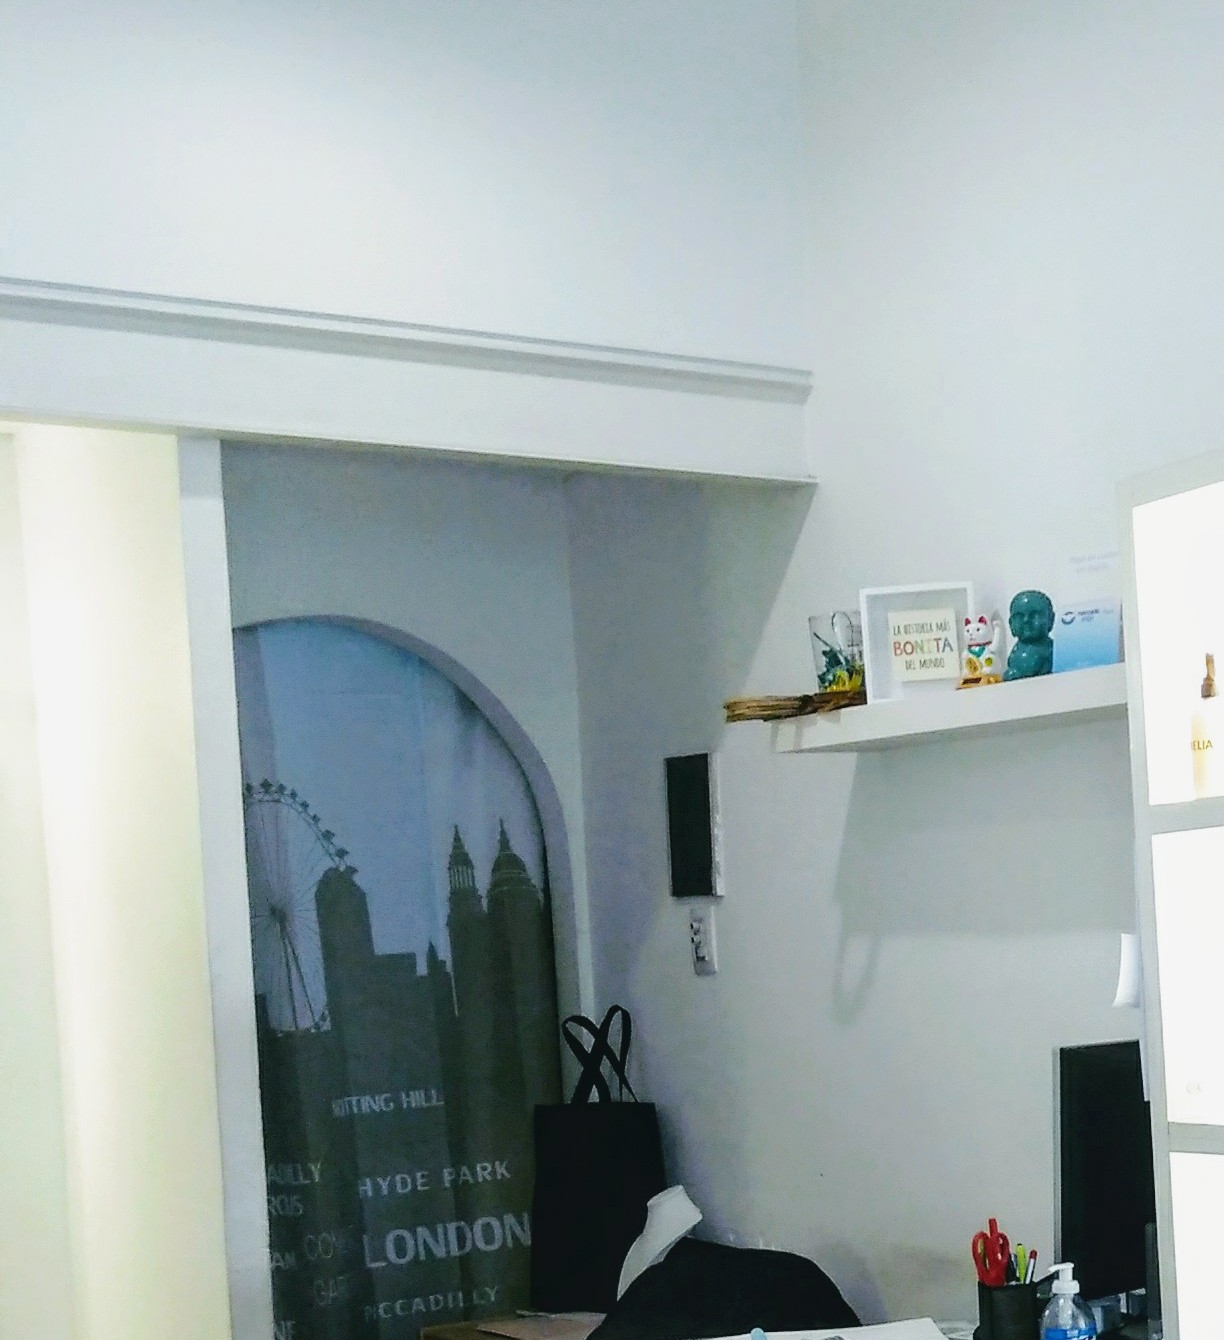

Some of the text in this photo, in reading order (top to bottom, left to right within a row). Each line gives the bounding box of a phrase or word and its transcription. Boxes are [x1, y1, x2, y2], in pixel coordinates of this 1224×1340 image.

[893, 625, 901, 636] LA
[893, 637, 954, 657] BONITA
[905, 657, 945, 671] DEL MUNDO
[1191, 739, 1213, 751] ELIA
[401, 1088, 445, 1109] HILL
[359, 1160, 512, 1199] HYDE PARK
[362, 1212, 532, 1268] LONDON
